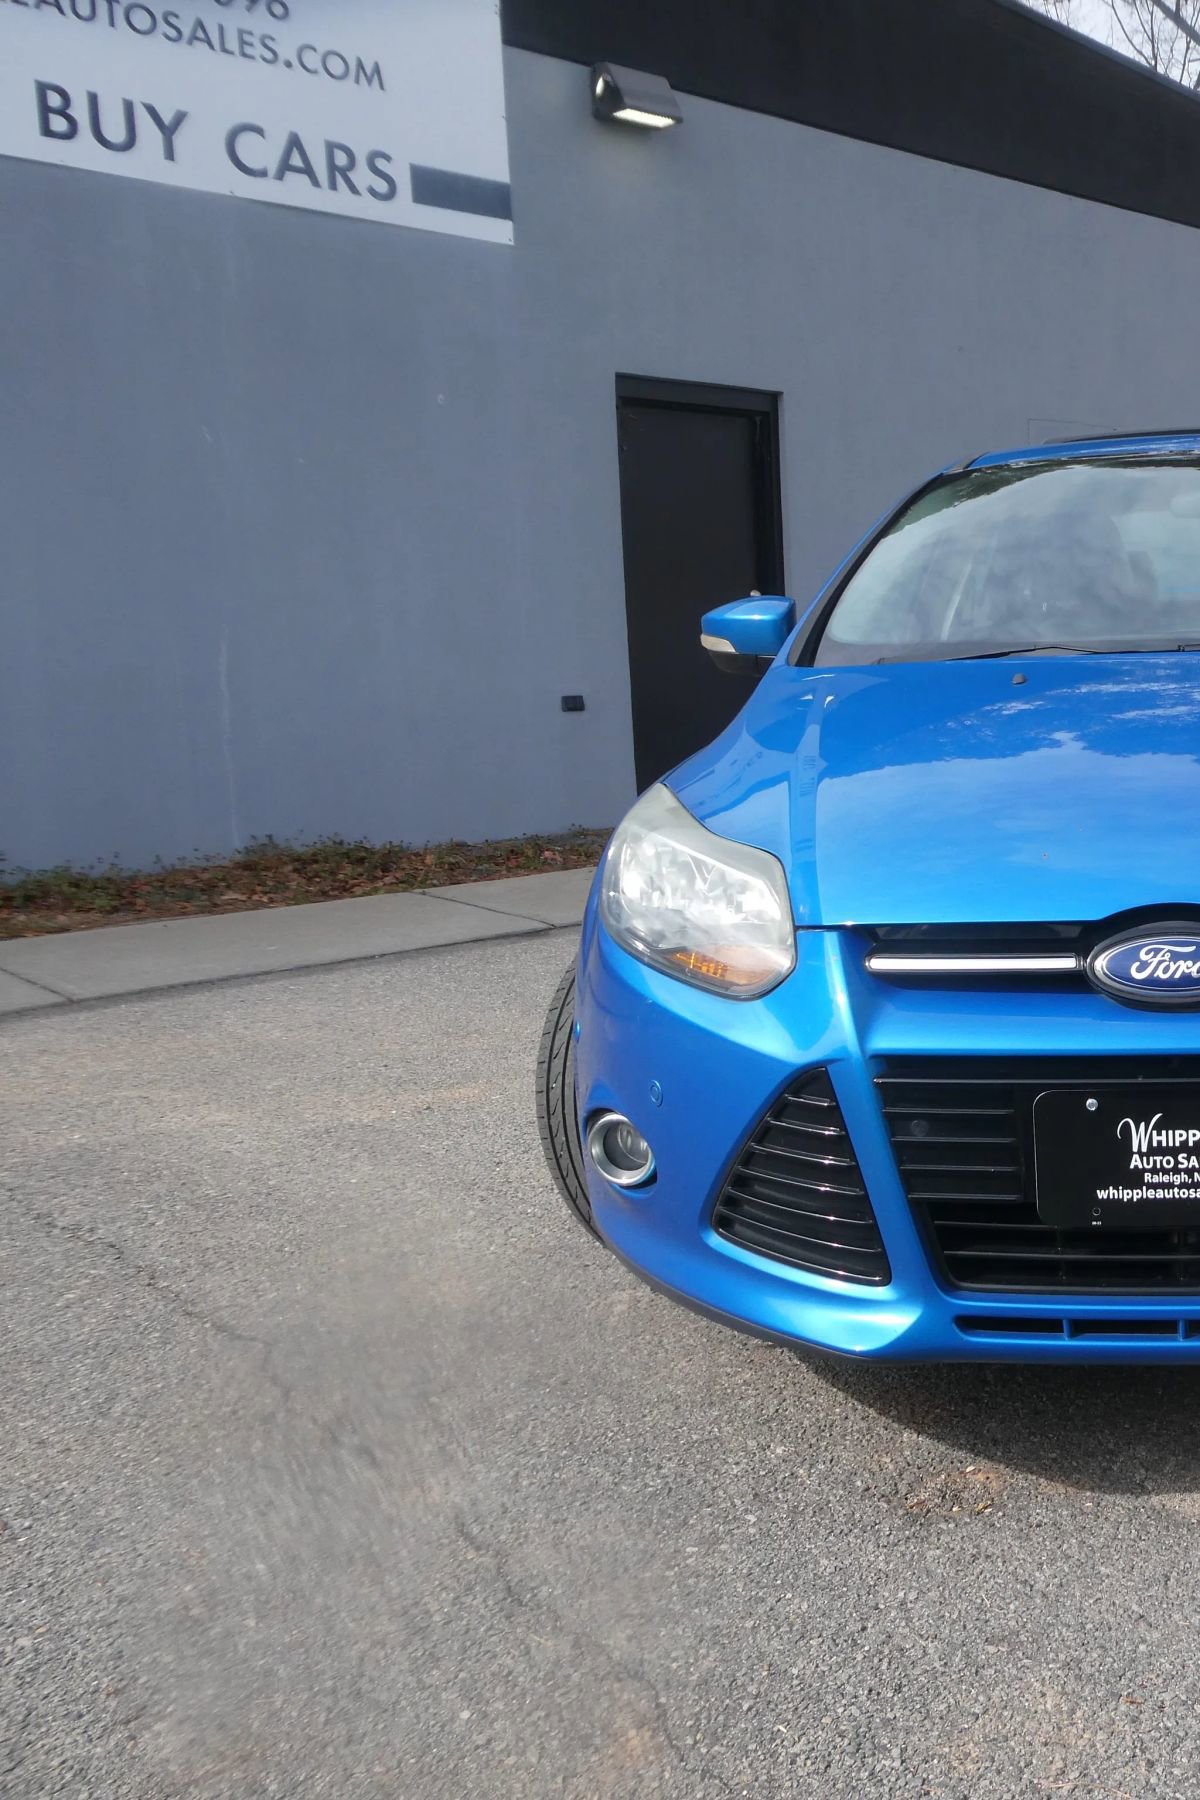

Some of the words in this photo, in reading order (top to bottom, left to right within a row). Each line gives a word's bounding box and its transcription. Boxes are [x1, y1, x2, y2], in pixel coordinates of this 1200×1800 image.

[10, 0, 386, 91] UTOSALES.COM
[34, 79, 189, 163] BUY
[223, 121, 398, 202] CARS
[1129, 1154, 1175, 1169] AUTO
[1144, 1171, 1192, 1185] Raleigh,
